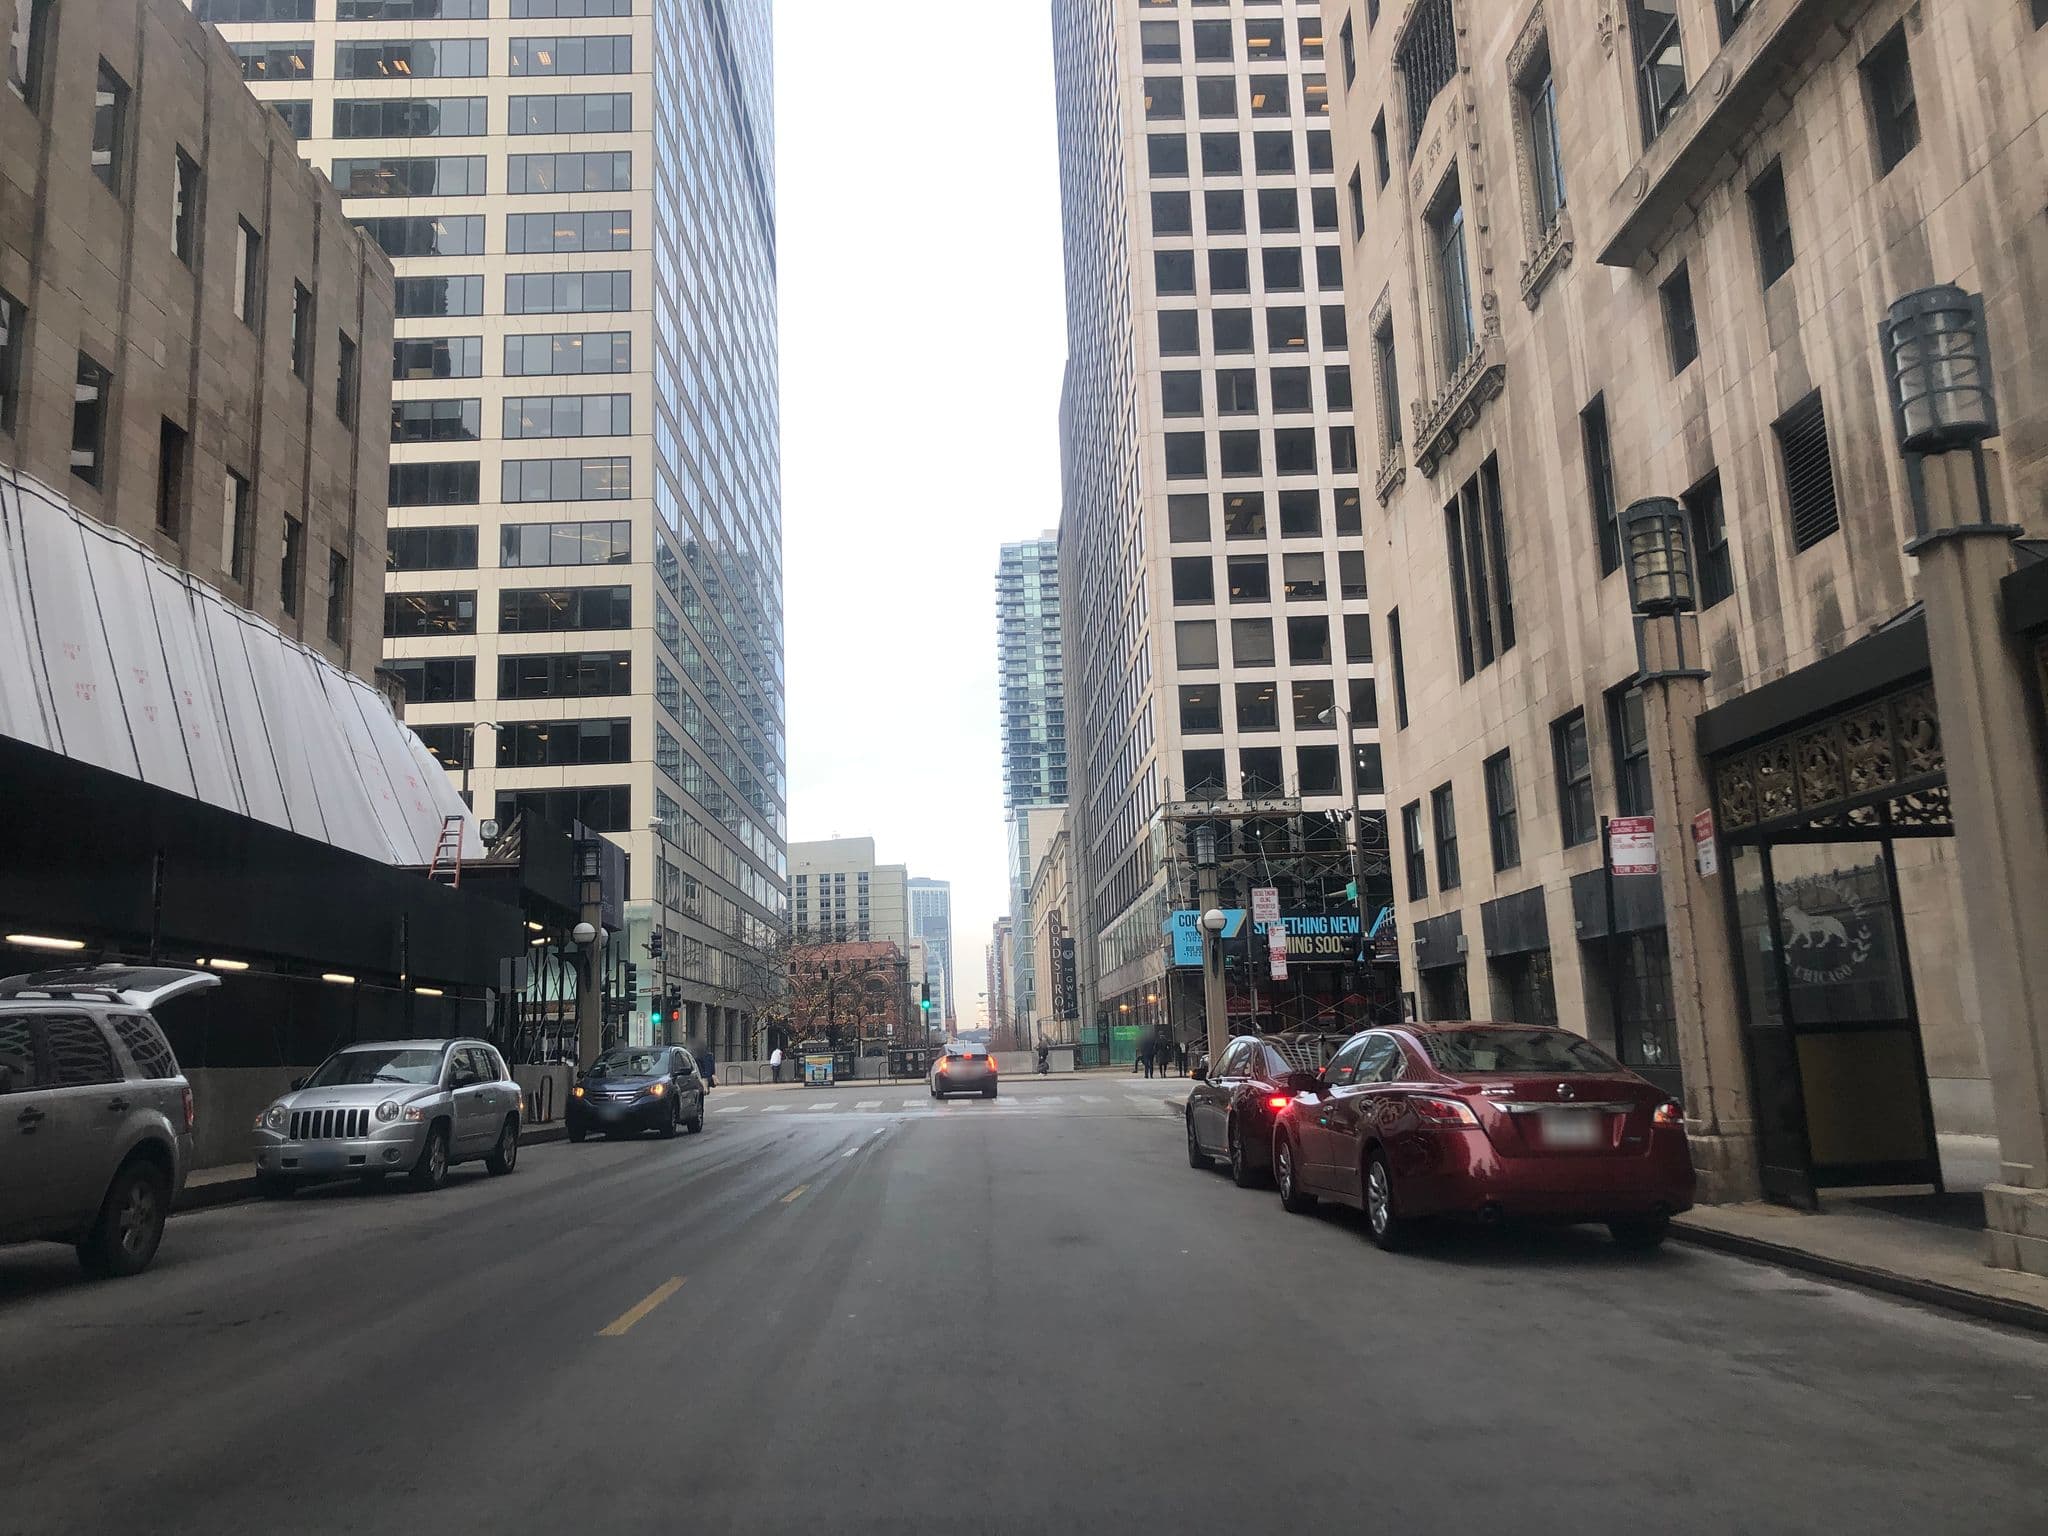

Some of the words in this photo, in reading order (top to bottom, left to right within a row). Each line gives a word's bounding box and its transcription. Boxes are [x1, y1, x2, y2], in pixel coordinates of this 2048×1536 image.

[1615, 866, 1630, 874] TOW
[1633, 865, 1653, 873] ZONE
[1330, 916, 1360, 934] NEW
[1051, 912, 1065, 1019] NORDSTROM
[1794, 964, 1853, 983] CHICAGO
